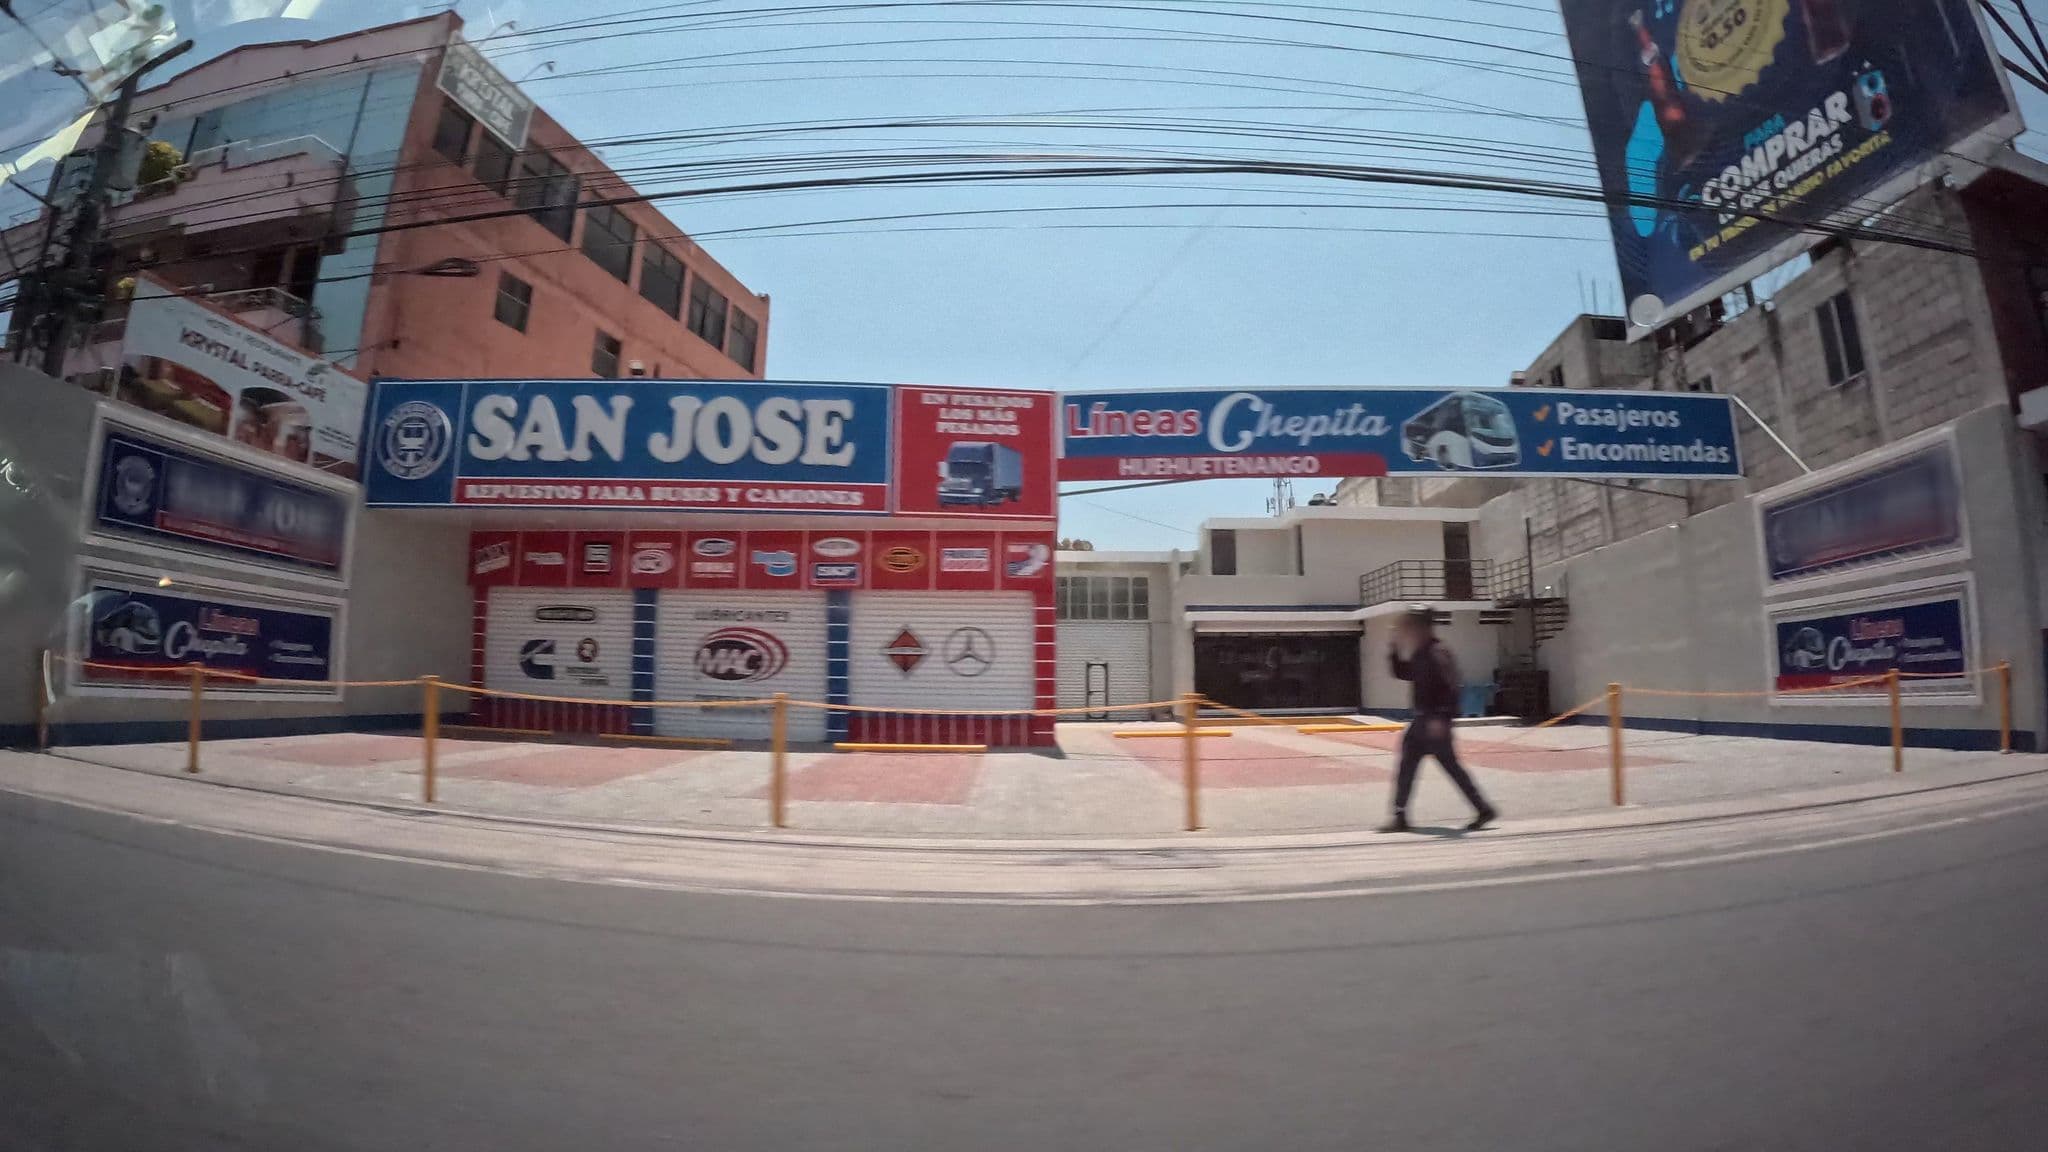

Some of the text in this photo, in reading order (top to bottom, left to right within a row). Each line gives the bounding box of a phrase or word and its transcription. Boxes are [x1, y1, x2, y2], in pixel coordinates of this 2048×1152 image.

[1702, 90, 1852, 206] COMPRAR
[1774, 134, 1844, 189] QUIERAS
[178, 324, 249, 372] KRYSTAL
[468, 394, 635, 463] SAN
[647, 395, 856, 467] JOSE
[1065, 391, 1392, 453] Líneas Chepita
[1556, 401, 1681, 433] Pasajeros
[1118, 455, 1321, 476] HUEHUETENANGO
[1560, 437, 1732, 464] Encomiendas
[465, 484, 864, 506] REPUESTOS PARA BUSES Y CAMIONES
[698, 648, 764, 676] MAC
